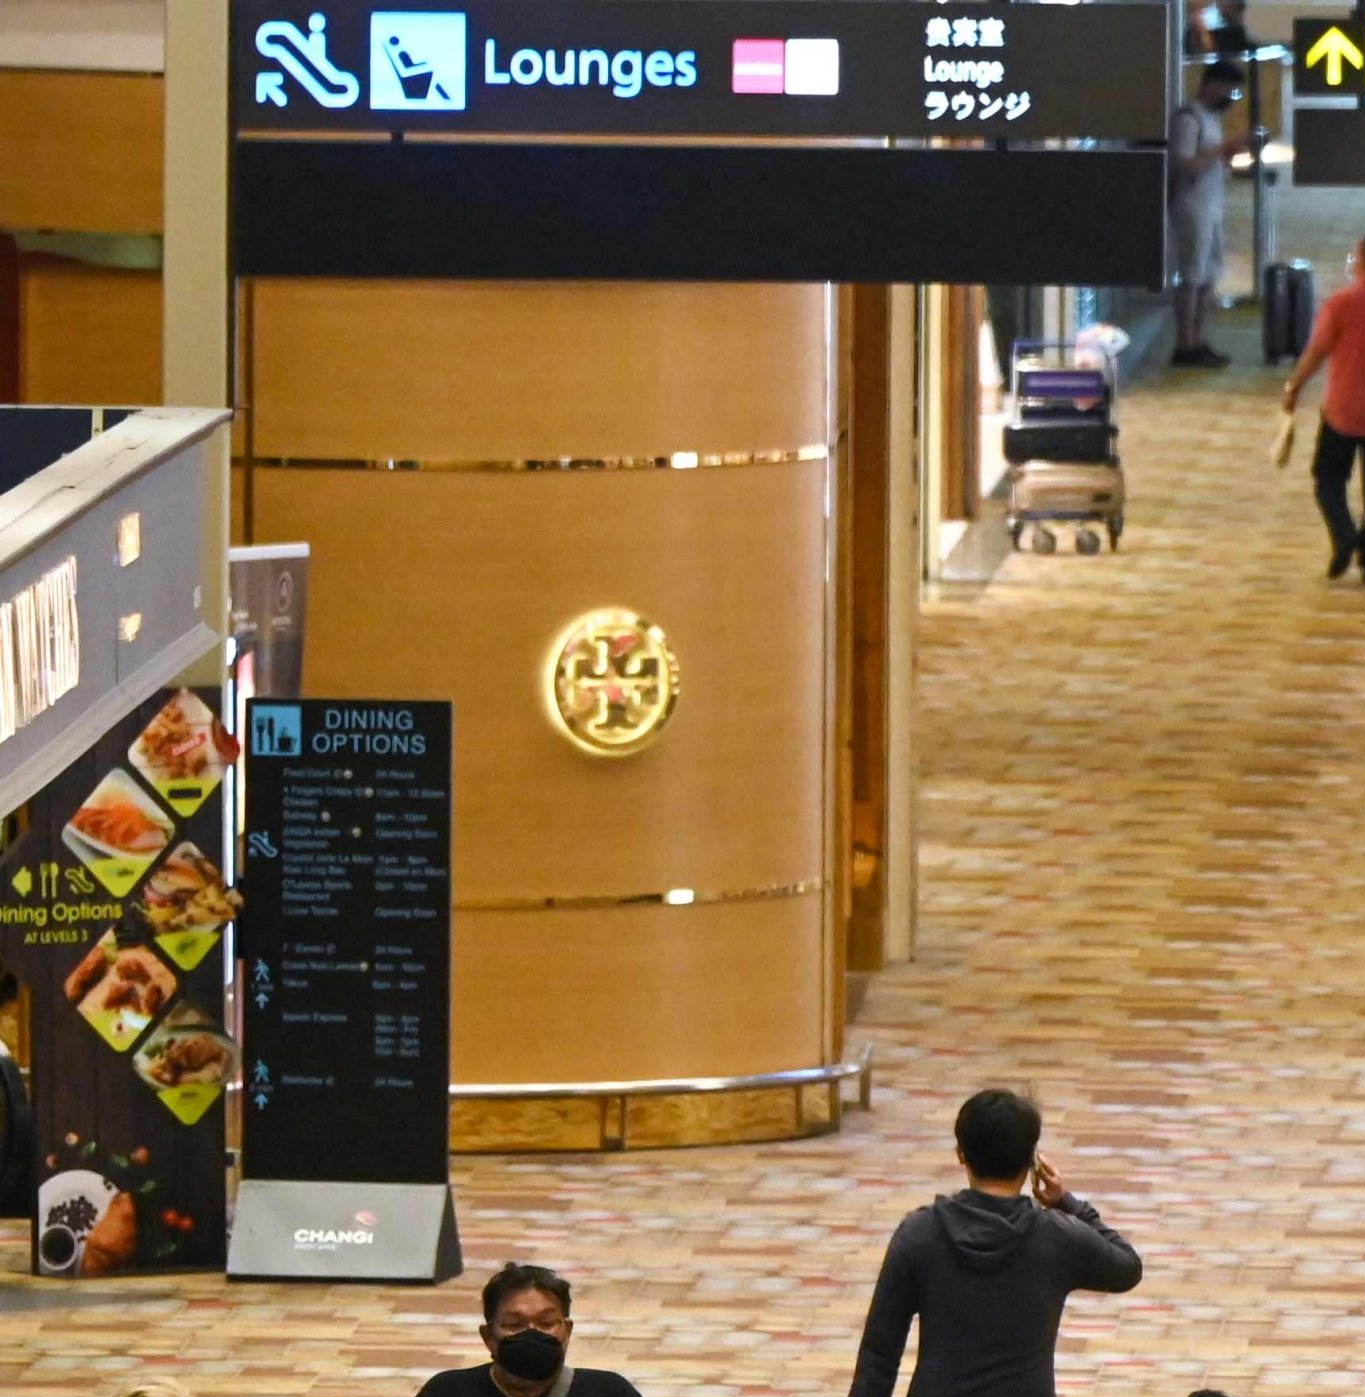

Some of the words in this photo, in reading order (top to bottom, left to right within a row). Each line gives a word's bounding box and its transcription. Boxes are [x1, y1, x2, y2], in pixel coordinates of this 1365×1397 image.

[484, 38, 697, 98] Lounges
[924, 55, 1004, 88] Lounge
[925, 91, 1030, 121] ラウンジ
[325, 709, 413, 731] DINING
[312, 733, 426, 755] OPTIONS
[0, 904, 48, 927] ining
[52, 902, 122, 924] Options
[294, 1228, 374, 1244] CHANGI
